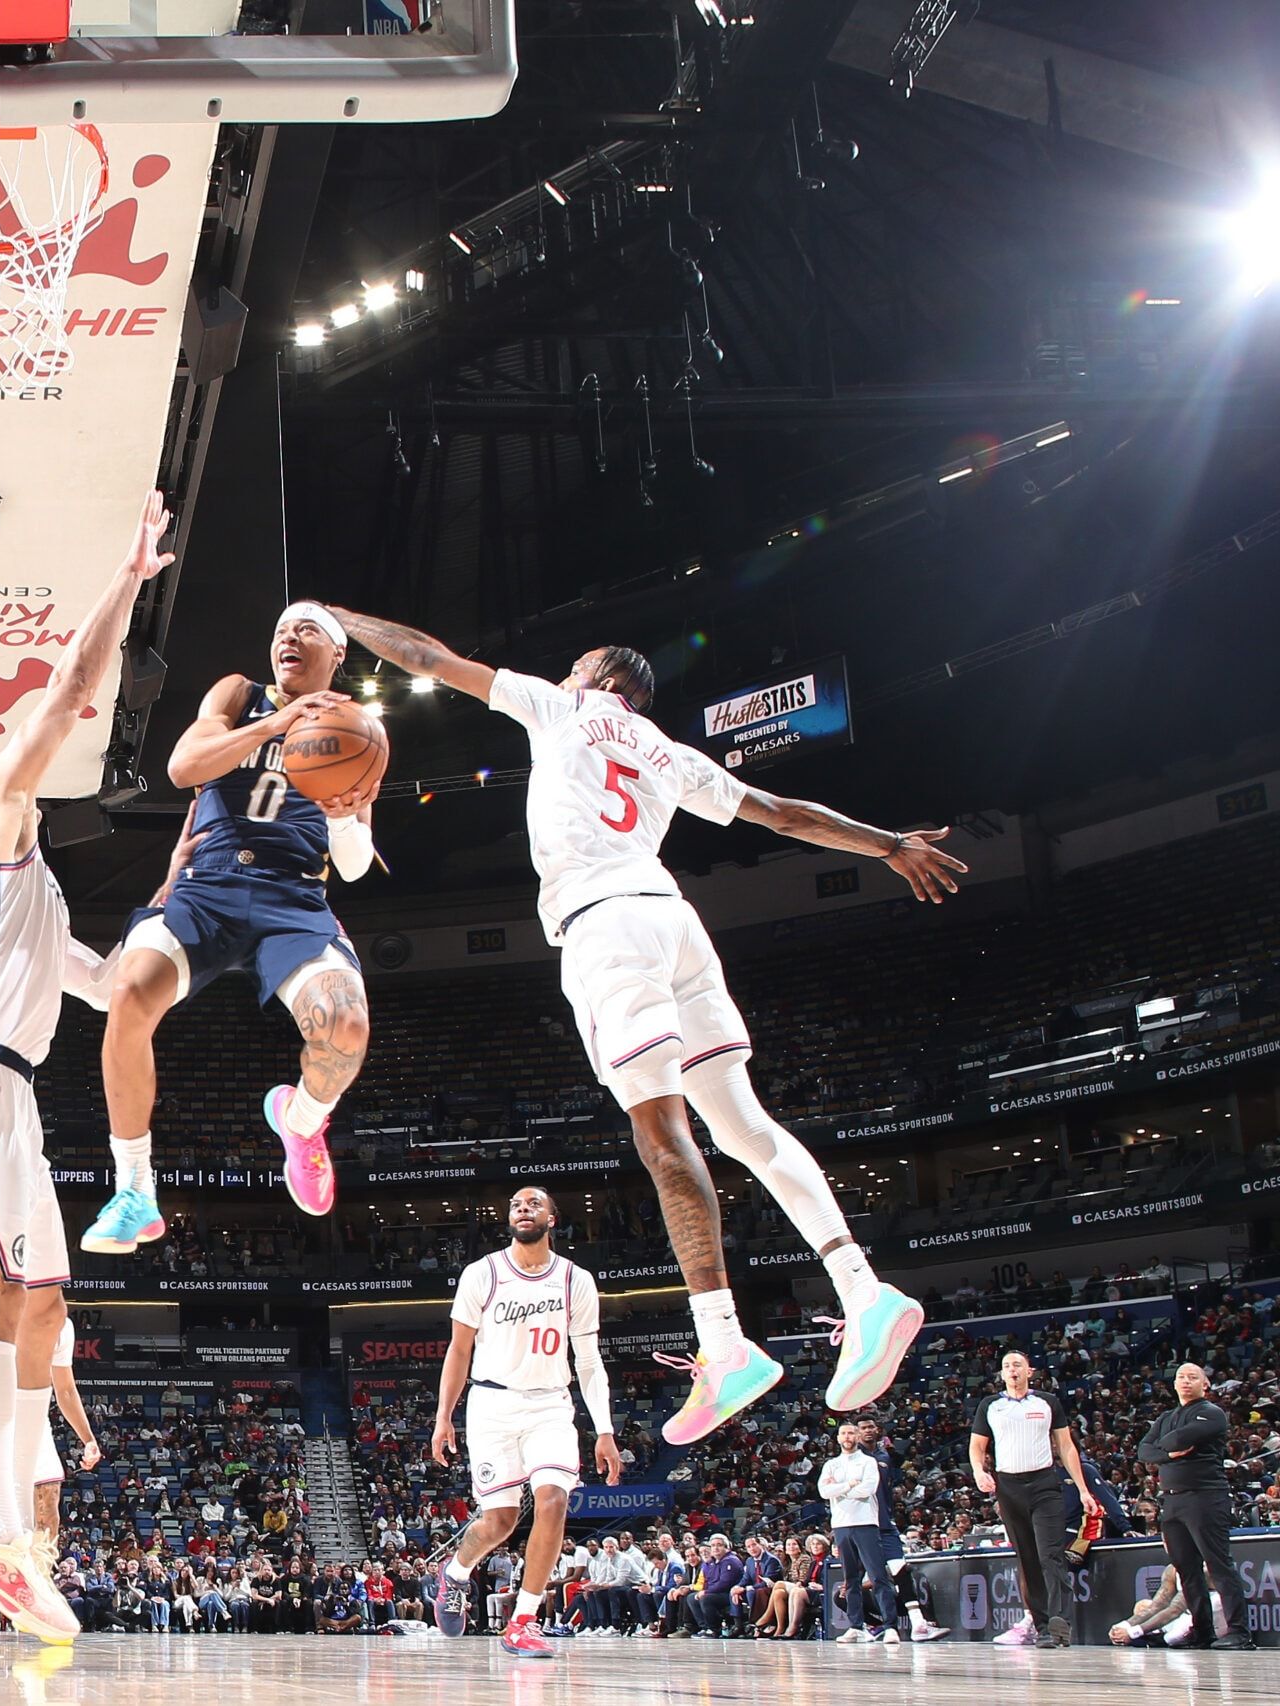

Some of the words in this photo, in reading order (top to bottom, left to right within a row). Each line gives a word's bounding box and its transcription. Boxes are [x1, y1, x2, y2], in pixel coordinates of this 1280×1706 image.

[373, 19, 400, 36] NBA
[579, 718, 638, 750] JONES
[734, 724, 777, 744] PRESENTED
[776, 719, 789, 731] BY
[744, 731, 801, 756] CAESARS
[246, 770, 288, 823] 0
[600, 759, 640, 833] 5
[470, 931, 502, 948] 310
[1169, 1057, 1222, 1079] CAESARS
[1223, 1042, 1280, 1066] SPORTSBOOK
[1001, 1093, 1052, 1112] CAESARS
[1053, 1080, 1114, 1101] SPORTSBOOK
[848, 1123, 897, 1138] CAESARS
[899, 1112, 954, 1132] SPORTSBOOK
[520, 1163, 565, 1174] CAESARS
[567, 1159, 620, 1172] SPORTSBOOK
[161, 1173, 174, 1183] 15
[183, 1174, 193, 1182] RB
[208, 1173, 215, 1183] 6
[258, 1174, 263, 1183] 1
[378, 1168, 423, 1181] CAESARS
[424, 1168, 476, 1179] SPORTSBOOK
[1253, 1177, 1280, 1192] CAES
[1084, 1205, 1140, 1224] CAESARS
[1143, 1193, 1203, 1215] SPORTSBOOK
[920, 1230, 969, 1248] CAESARS
[971, 1221, 1032, 1241] SPORTSBOOK
[760, 1251, 810, 1266] CAESARS
[608, 1267, 655, 1279] CAESARS
[73, 1280, 126, 1289] SPORTSBOOK
[170, 1281, 215, 1291] CAESARS
[216, 1281, 269, 1291] SPORTSBOOK
[312, 1281, 358, 1292] CAESARS
[360, 1279, 412, 1290] SPORTSBOOK
[493, 1297, 564, 1326] Clippers
[529, 1327, 561, 1356] 10
[611, 1334, 649, 1345] TICKETING
[650, 1332, 683, 1343] PARTNER
[684, 1330, 695, 1340] OF
[196, 1347, 223, 1356] OFFICIAL
[223, 1347, 253, 1356] TICKETING
[254, 1347, 281, 1356] PARTNER
[282, 1347, 291, 1355] OF
[361, 1340, 450, 1365] SEATGEE
[652, 1341, 689, 1351] PELICANS
[201, 1355, 213, 1363] THE
[214, 1355, 227, 1363] NEW
[227, 1355, 256, 1363] ORLEANS
[257, 1355, 285, 1363] PELICANS
[190, 1380, 214, 1388] PELICANS
[232, 1379, 271, 1390] SEATGEEK
[588, 1494, 665, 1509] FANDUEL
